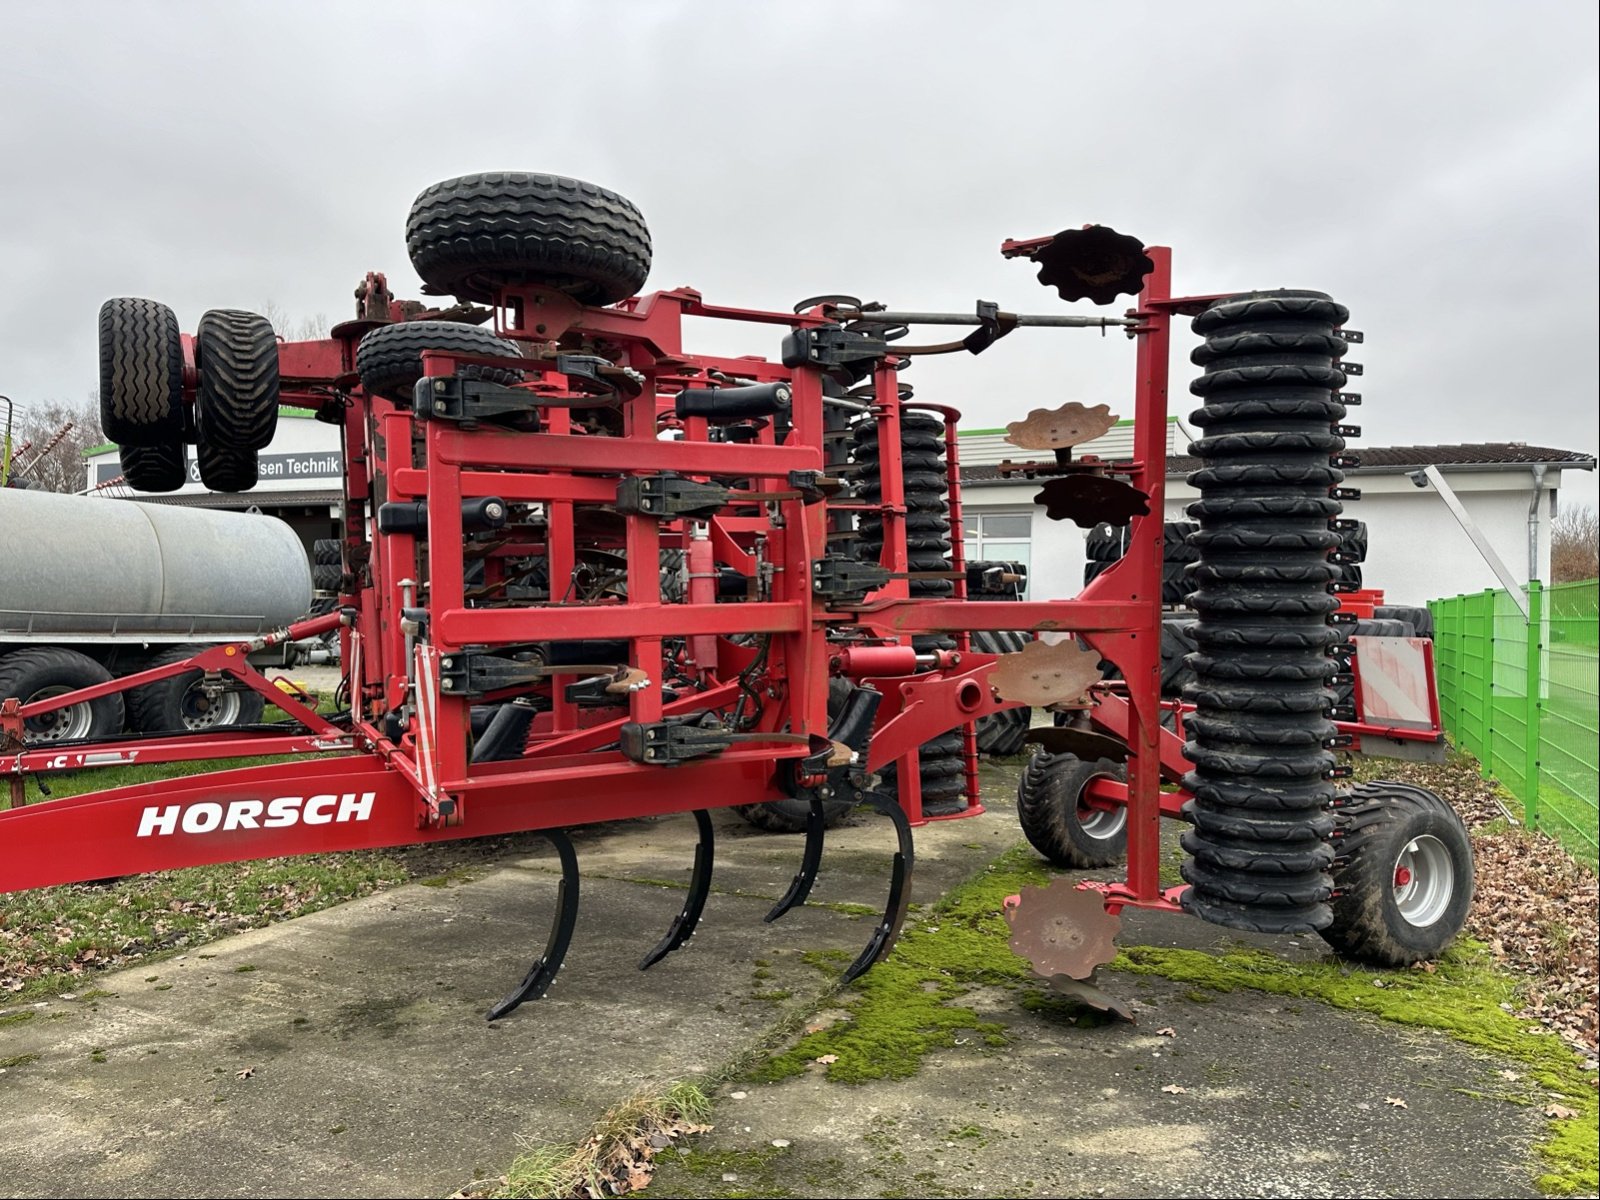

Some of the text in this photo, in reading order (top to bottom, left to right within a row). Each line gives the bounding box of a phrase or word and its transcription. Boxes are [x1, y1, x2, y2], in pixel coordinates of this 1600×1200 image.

[258, 457, 339, 476] isen Technik
[136, 791, 377, 838] HORSCH
